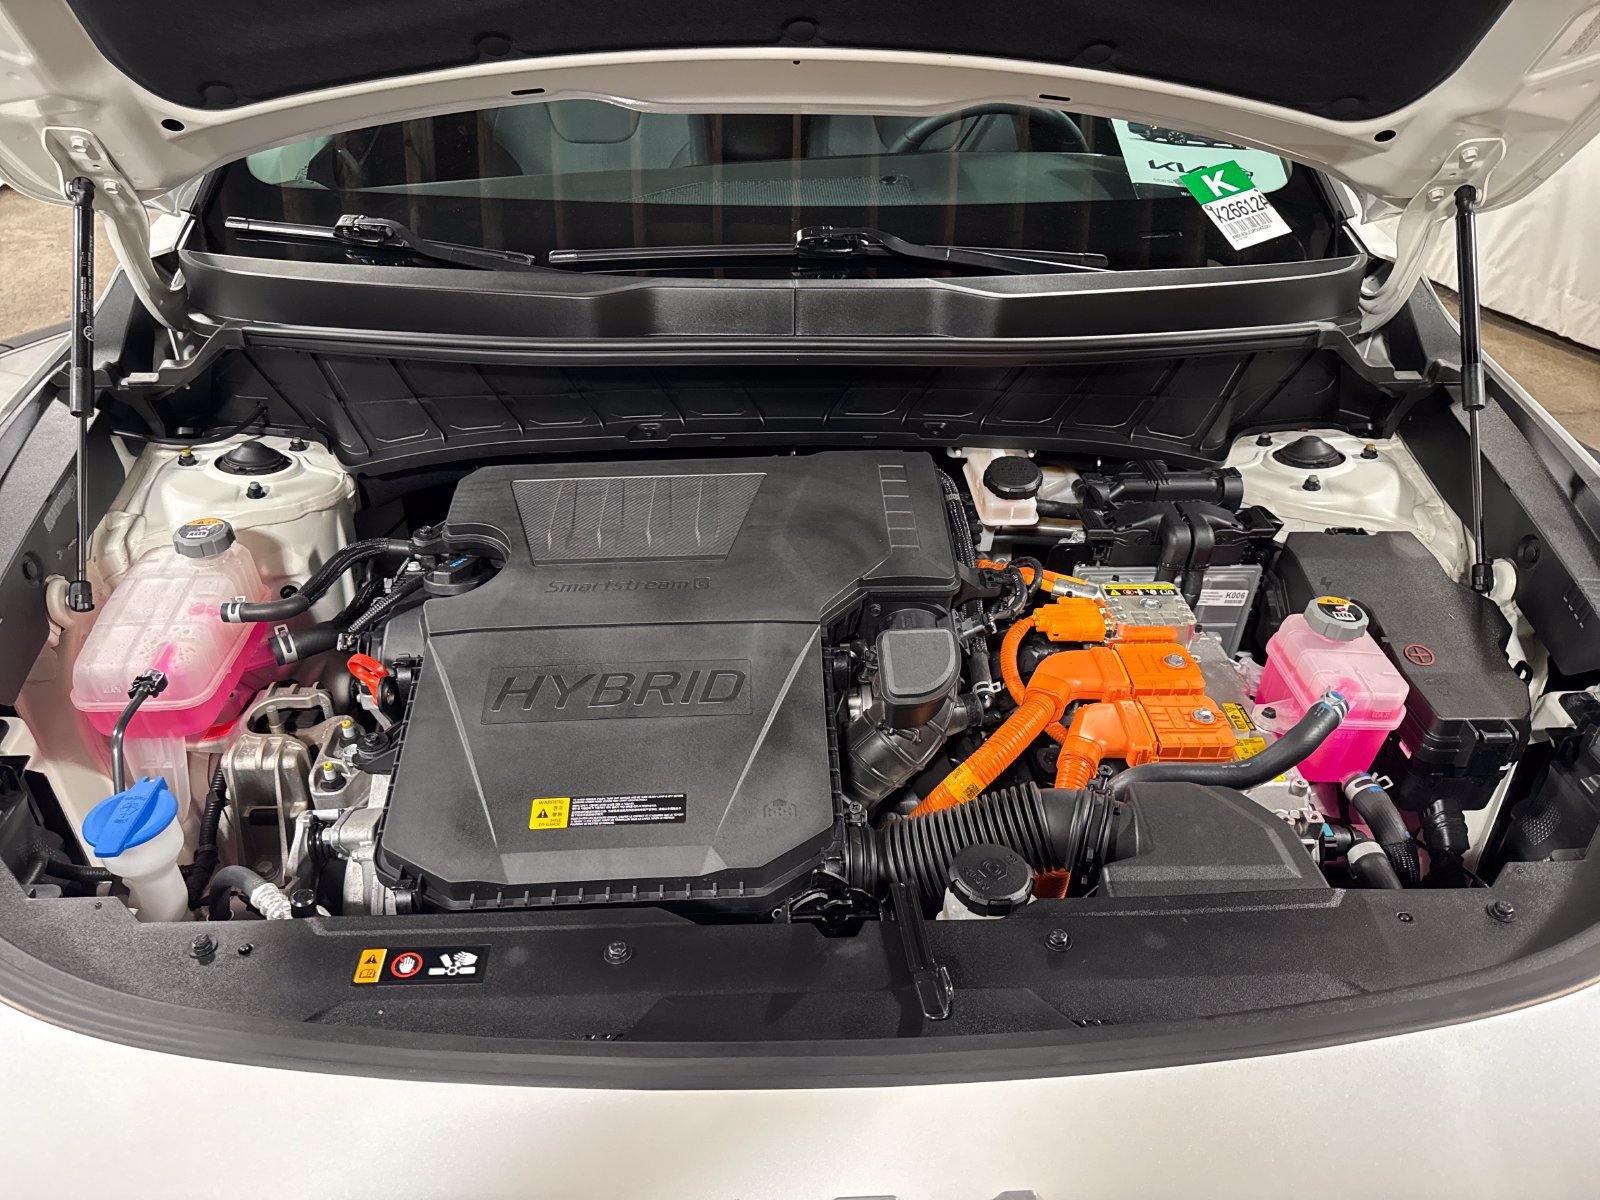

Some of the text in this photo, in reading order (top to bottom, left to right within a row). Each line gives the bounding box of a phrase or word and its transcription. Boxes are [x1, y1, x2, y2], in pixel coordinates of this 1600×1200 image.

[1200, 169, 1240, 197] K
[545, 578, 689, 594] Smartstream
[490, 669, 746, 713] HYBRID
